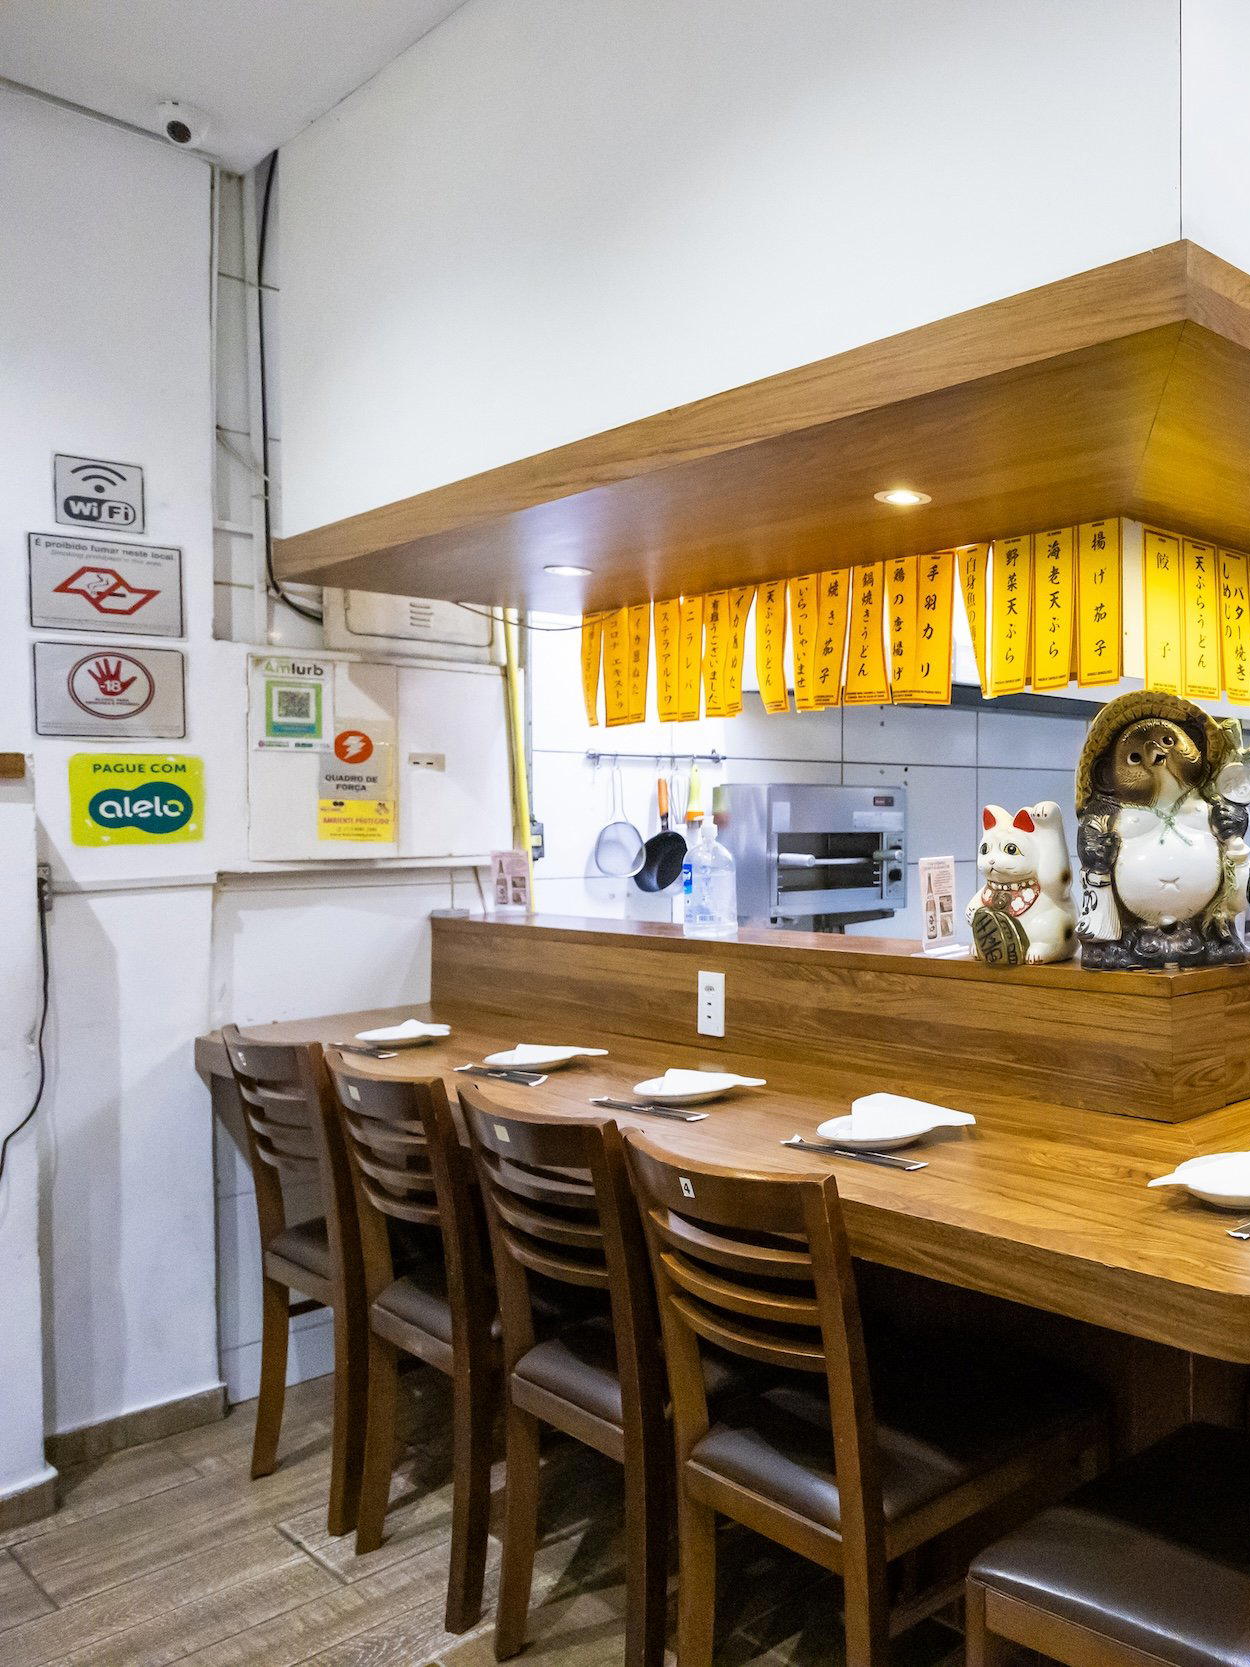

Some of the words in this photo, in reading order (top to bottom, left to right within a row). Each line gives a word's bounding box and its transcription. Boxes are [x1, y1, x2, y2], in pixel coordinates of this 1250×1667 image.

[34, 537, 42, 547] É
[45, 541, 88, 551] proibido
[90, 545, 119, 555] fumar
[122, 550, 148, 558] neste
[151, 552, 174, 561] local
[1046, 540, 1061, 658] 海老天ぷら
[1091, 531, 1107, 657] 揚げ茄子
[819, 579, 839, 685] 焼き茄子
[857, 571, 875, 678] 鍋焼きうどん
[893, 567, 906, 681] 鶏の唐揚げ
[1005, 548, 1019, 664] 野菜天ぷら
[264, 661, 324, 676] Amlurb
[92, 763, 147, 774] PAGUE
[150, 763, 187, 774] COM
[98, 795, 185, 819] alelo
[325, 774, 364, 783] QUADRO
[365, 775, 378, 784] DE
